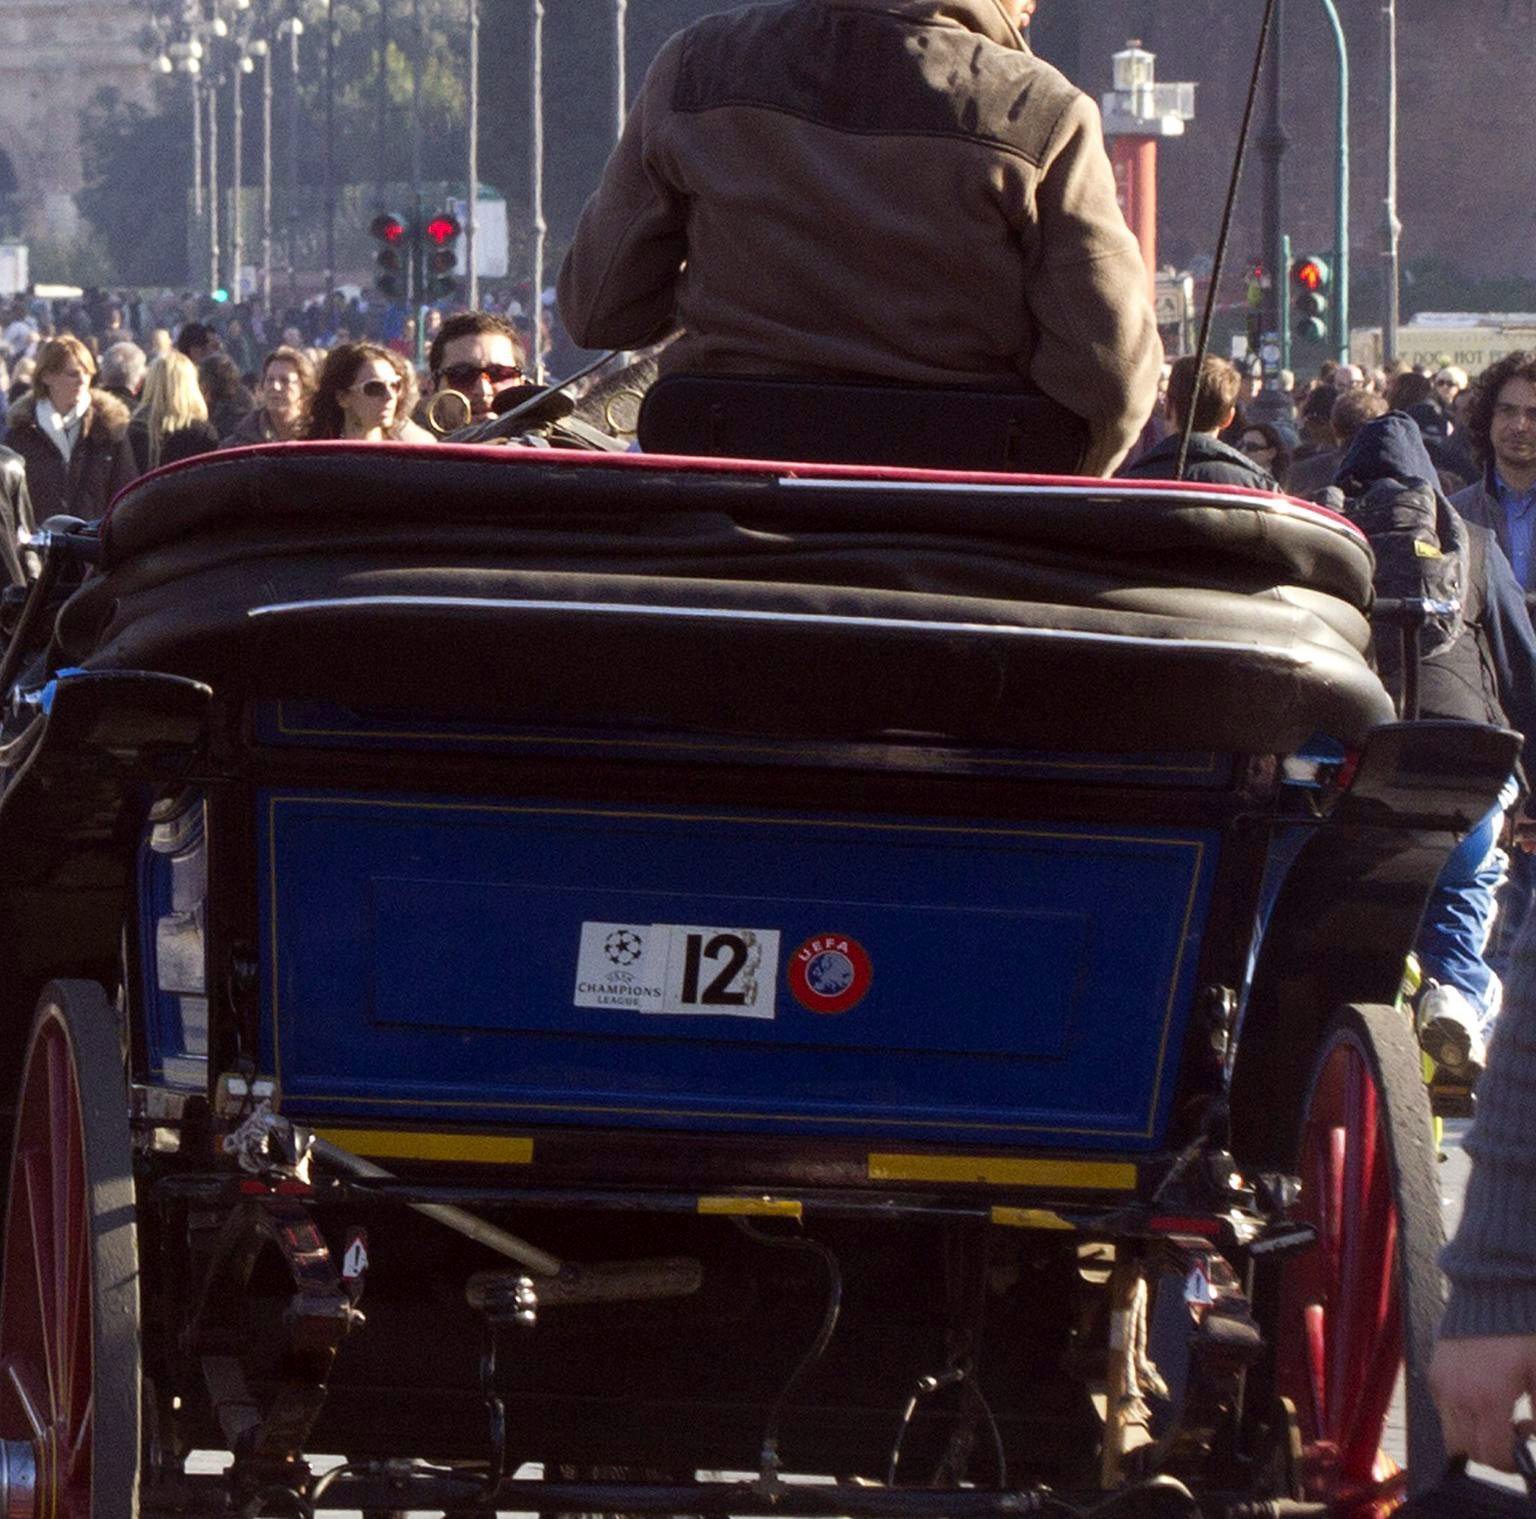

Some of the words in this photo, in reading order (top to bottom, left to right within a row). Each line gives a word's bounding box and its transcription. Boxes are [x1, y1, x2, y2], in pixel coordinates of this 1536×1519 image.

[1454, 350, 1483, 365] HOT
[798, 938, 849, 961] UEFA
[682, 933, 748, 1005] 12
[578, 982, 662, 997] CHAMPIONS
[597, 994, 640, 1007] LEAGUE
